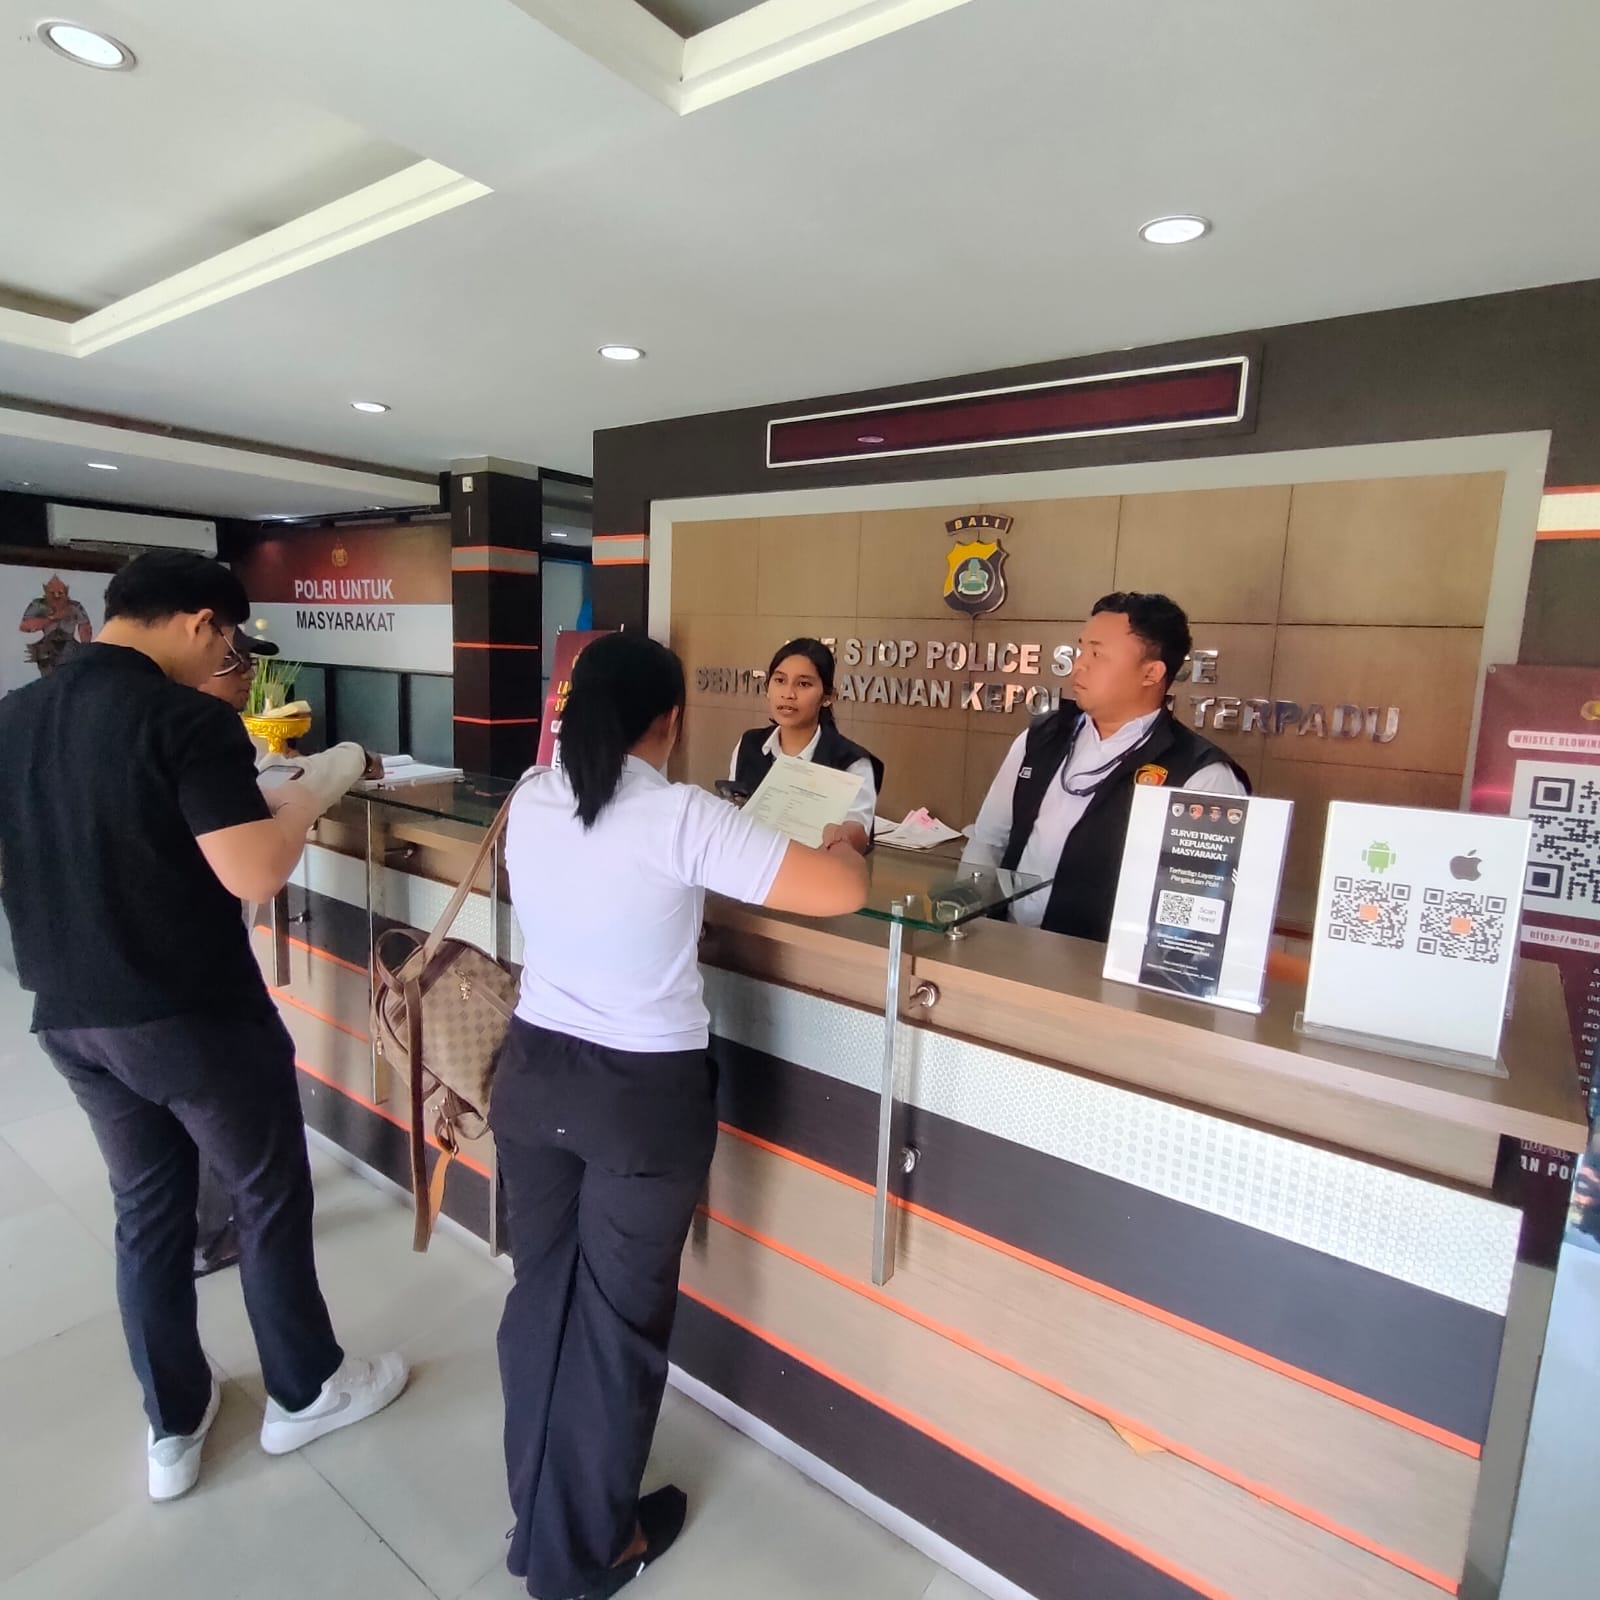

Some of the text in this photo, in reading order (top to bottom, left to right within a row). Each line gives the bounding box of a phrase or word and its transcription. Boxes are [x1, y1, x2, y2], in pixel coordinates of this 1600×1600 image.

[955, 516, 1000, 530] BALI
[294, 579, 394, 600] POLRI UNTUK
[296, 610, 395, 632] MASYARAKAT
[844, 638, 918, 669] STOP
[926, 640, 1042, 675] POLICE
[696, 667, 769, 696] SENTR
[838, 673, 952, 708] AYANAN
[1190, 696, 1401, 743] TERPADU
[1179, 838, 1224, 852] KEPUASAN
[1199, 832, 1236, 844] TINGKAT
[1171, 846, 1228, 862] MASYARAKAT
